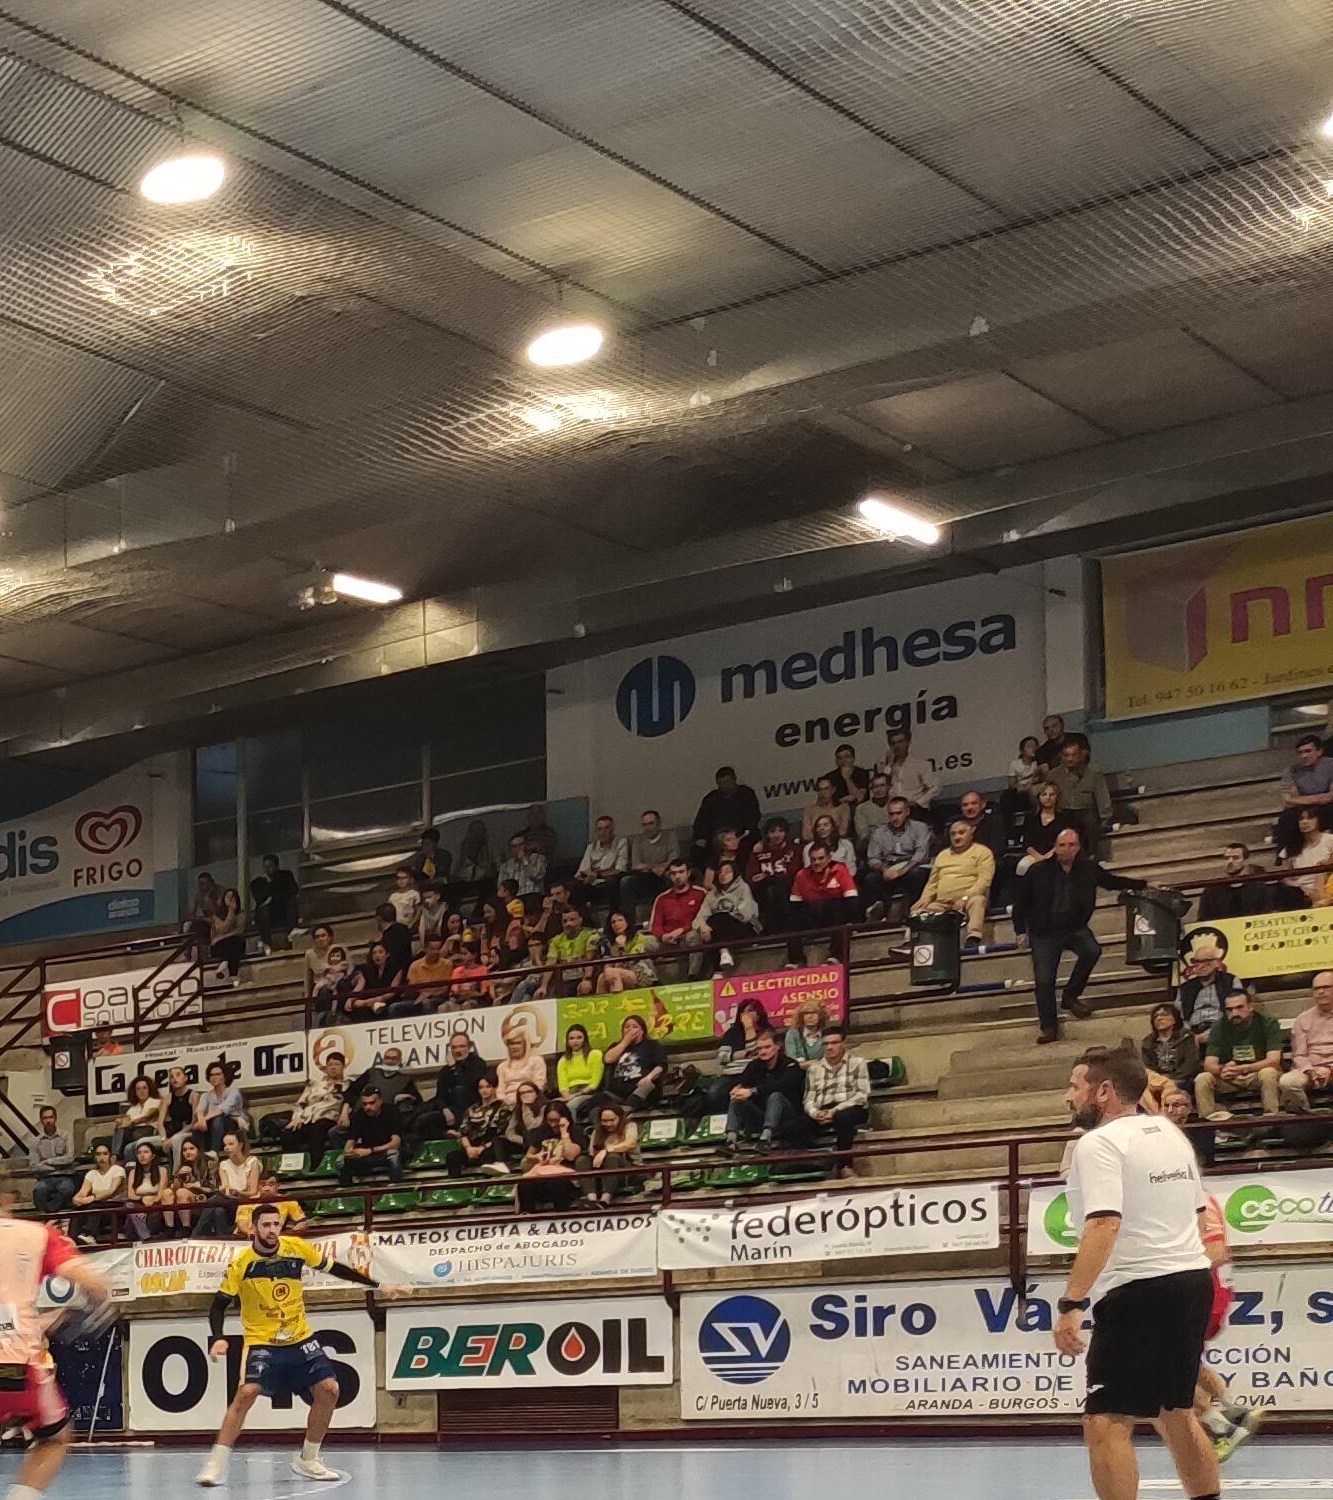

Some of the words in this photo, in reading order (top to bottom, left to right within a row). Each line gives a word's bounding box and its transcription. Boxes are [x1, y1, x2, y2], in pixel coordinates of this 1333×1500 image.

[721, 614, 1016, 703] medhesa
[775, 689, 958, 748] energía
[73, 857, 143, 888] FRIGO
[1244, 926, 1280, 941] CAFÉS
[741, 971, 839, 992] ELECTRICIDAD
[781, 989, 839, 1005] ASENSIO
[366, 1013, 486, 1046] TELEVISIÓN
[253, 1042, 304, 1077] Oro
[730, 1194, 988, 1240] federópticos
[456, 1223, 520, 1241] CUESTA
[528, 1222, 540, 1235] &
[547, 1216, 653, 1235] ASOCIADOS
[429, 1243, 492, 1256] DESPACHO
[496, 1242, 510, 1251] de
[515, 1238, 584, 1249] ABOGADOS
[731, 1241, 792, 1261] Marín
[459, 1252, 578, 1273] HISPAJURIS
[811, 1294, 936, 1340] Siro
[392, 1317, 665, 1379] BEROIL
[896, 1352, 1076, 1371] SANEAMIENTO
[847, 1375, 1021, 1395] MOBILIARIO
[1034, 1375, 1073, 1391] DE
[709, 1393, 750, 1412] Puerta
[752, 1392, 794, 1412] Nueva,
[906, 1398, 975, 1410] ARANDA
[989, 1397, 1058, 1409] BURGOS
